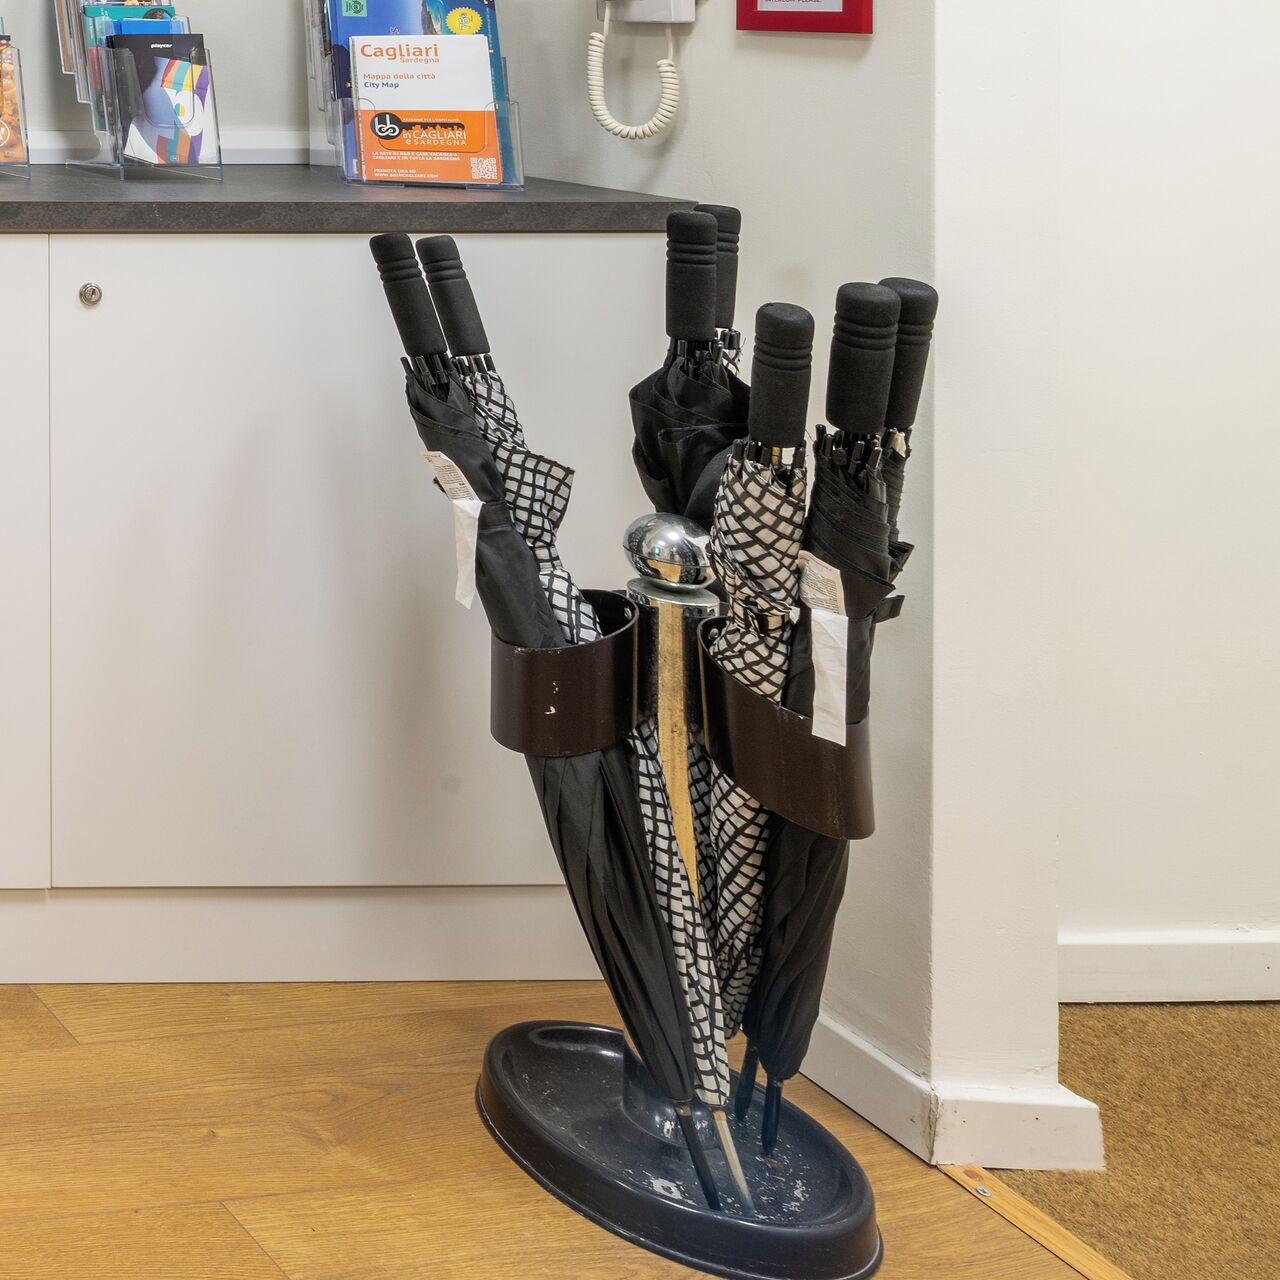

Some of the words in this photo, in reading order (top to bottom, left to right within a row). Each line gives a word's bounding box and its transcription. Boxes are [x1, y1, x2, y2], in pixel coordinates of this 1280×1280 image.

[360, 43, 439, 61] Cagliari
[399, 56, 440, 64] Sardegna
[363, 73, 391, 81] Mappa
[364, 81, 380, 89] City
[381, 81, 400, 89] Map
[412, 130, 467, 140] CAGLIARI
